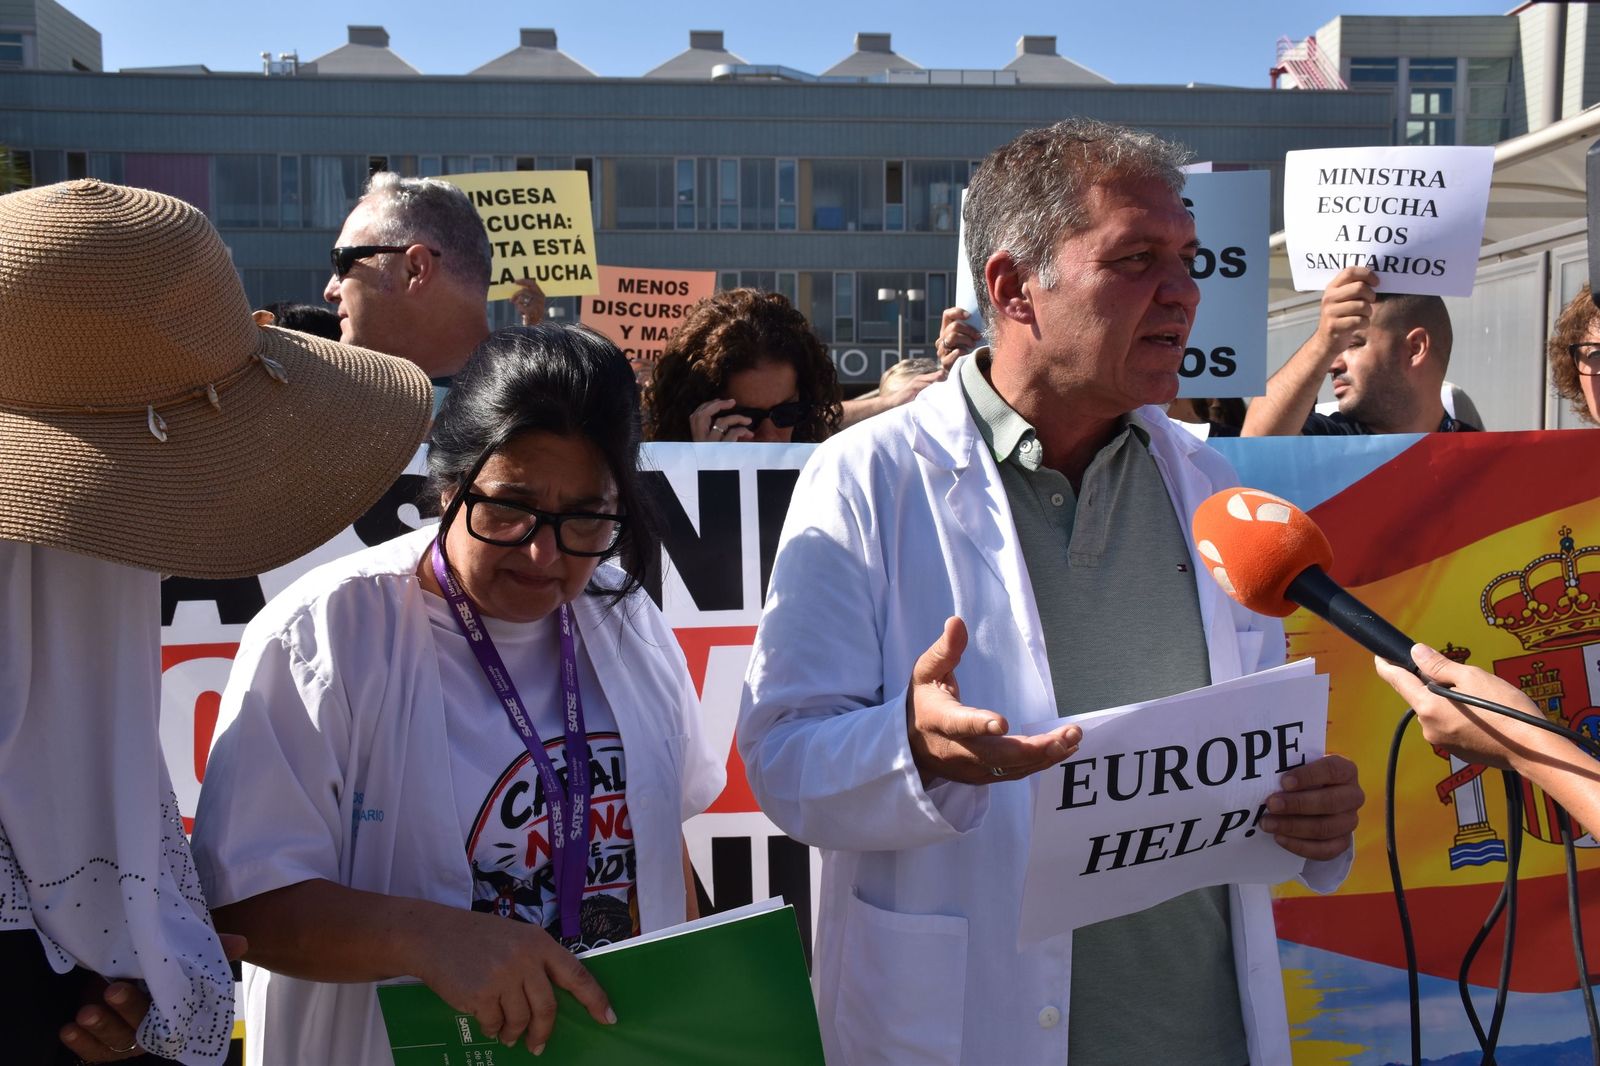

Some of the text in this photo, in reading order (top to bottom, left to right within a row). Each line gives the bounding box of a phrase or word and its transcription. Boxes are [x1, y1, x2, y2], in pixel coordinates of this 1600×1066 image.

[1317, 168, 1446, 189] MINISTRA
[468, 187, 556, 207] INGESA
[1316, 196, 1439, 218] ESCUCHA
[482, 213, 572, 232] CUCHA:
[533, 235, 586, 256] ESTÁ
[1335, 225, 1408, 245] A LOS
[523, 264, 593, 282] LUCHA
[1305, 252, 1447, 277] SANITARIOS
[618, 278, 689, 296] MENOS
[620, 324, 634, 340] Y
[455, 601, 483, 642] SATSE
[505, 697, 532, 737] SATSE
[567, 691, 579, 733] SATSE
[1055, 721, 1306, 811] EUROPE
[551, 800, 565, 849] SATSE
[570, 793, 584, 841] SATSE
[1079, 804, 1268, 877] HELP!
[459, 1017, 473, 1044] SATSE
